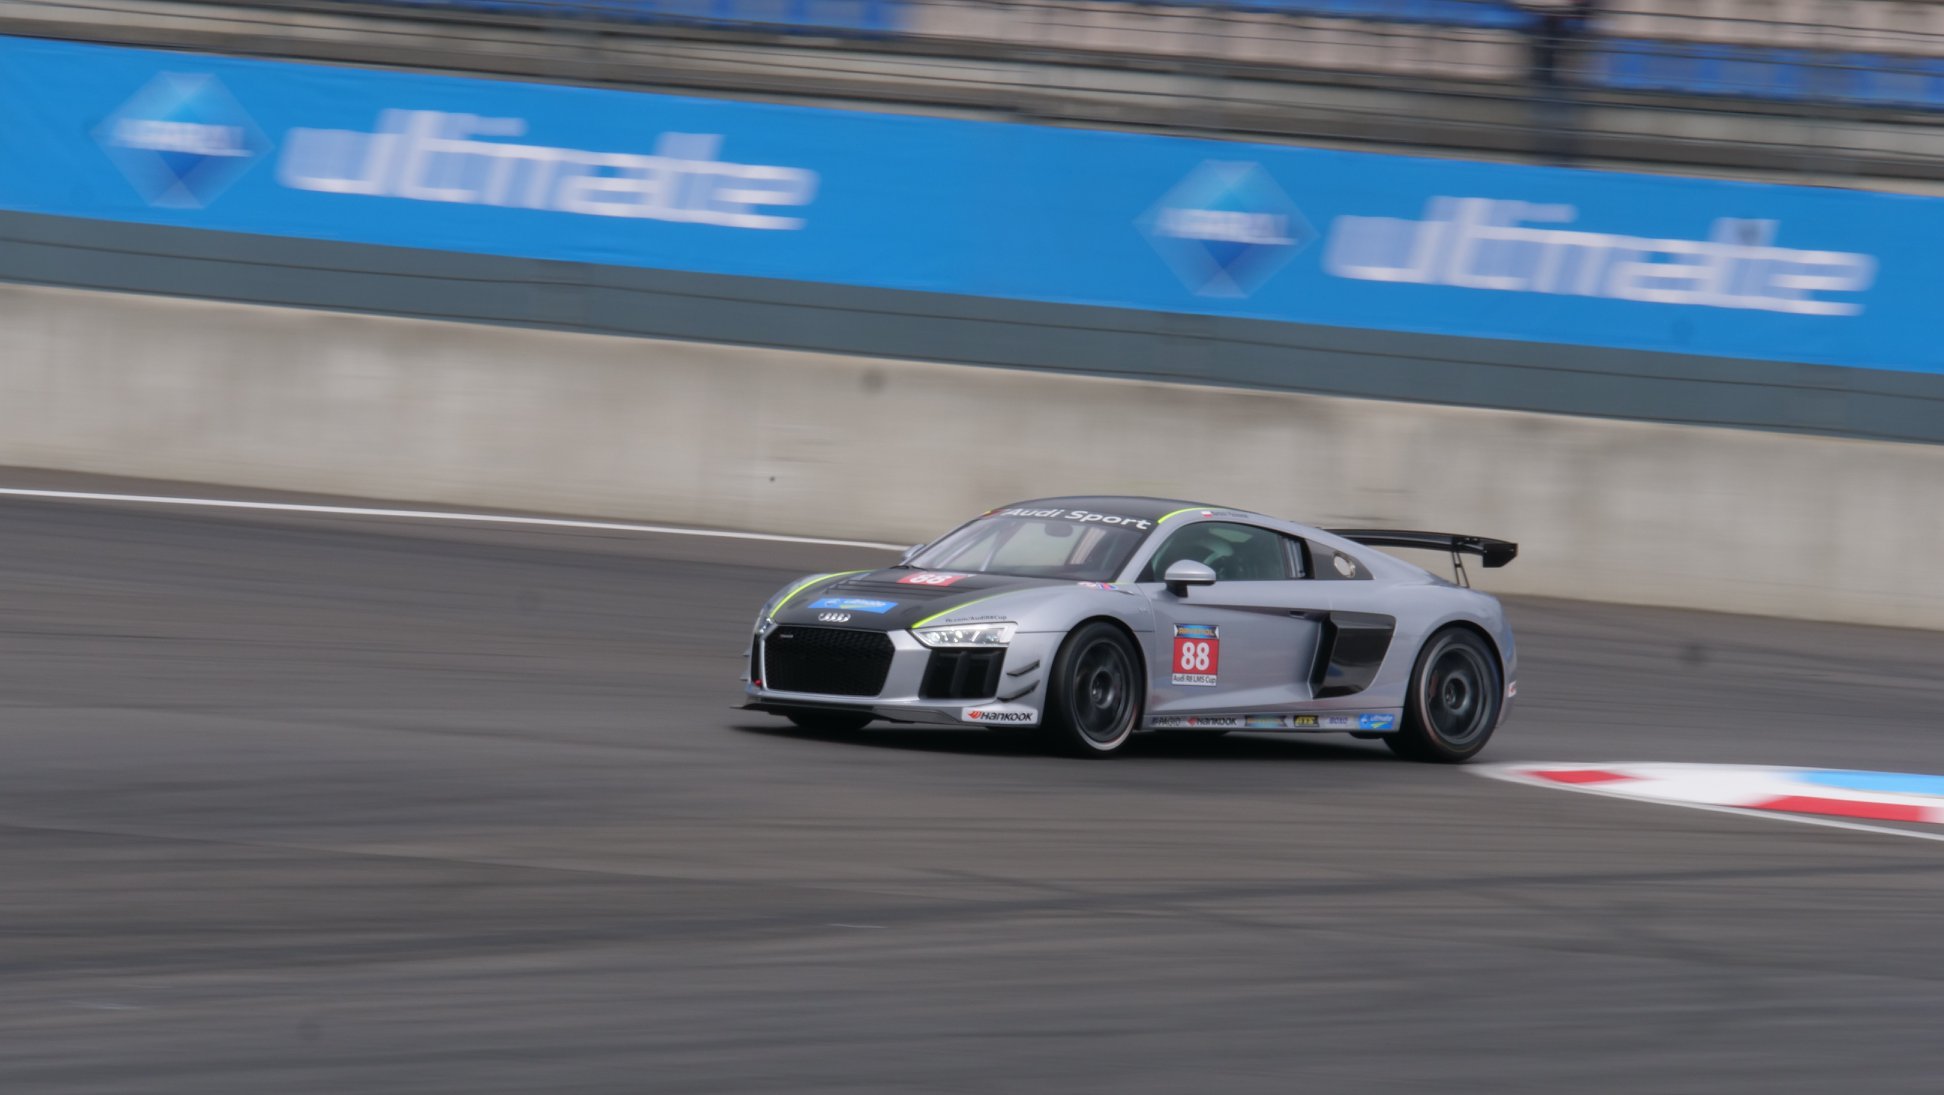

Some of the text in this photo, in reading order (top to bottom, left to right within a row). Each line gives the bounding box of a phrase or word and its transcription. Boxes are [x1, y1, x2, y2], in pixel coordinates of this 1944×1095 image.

[1001, 508, 1151, 530] Audi Sport
[1181, 641, 1210, 670] 88
[1173, 674, 1185, 682] Audi
